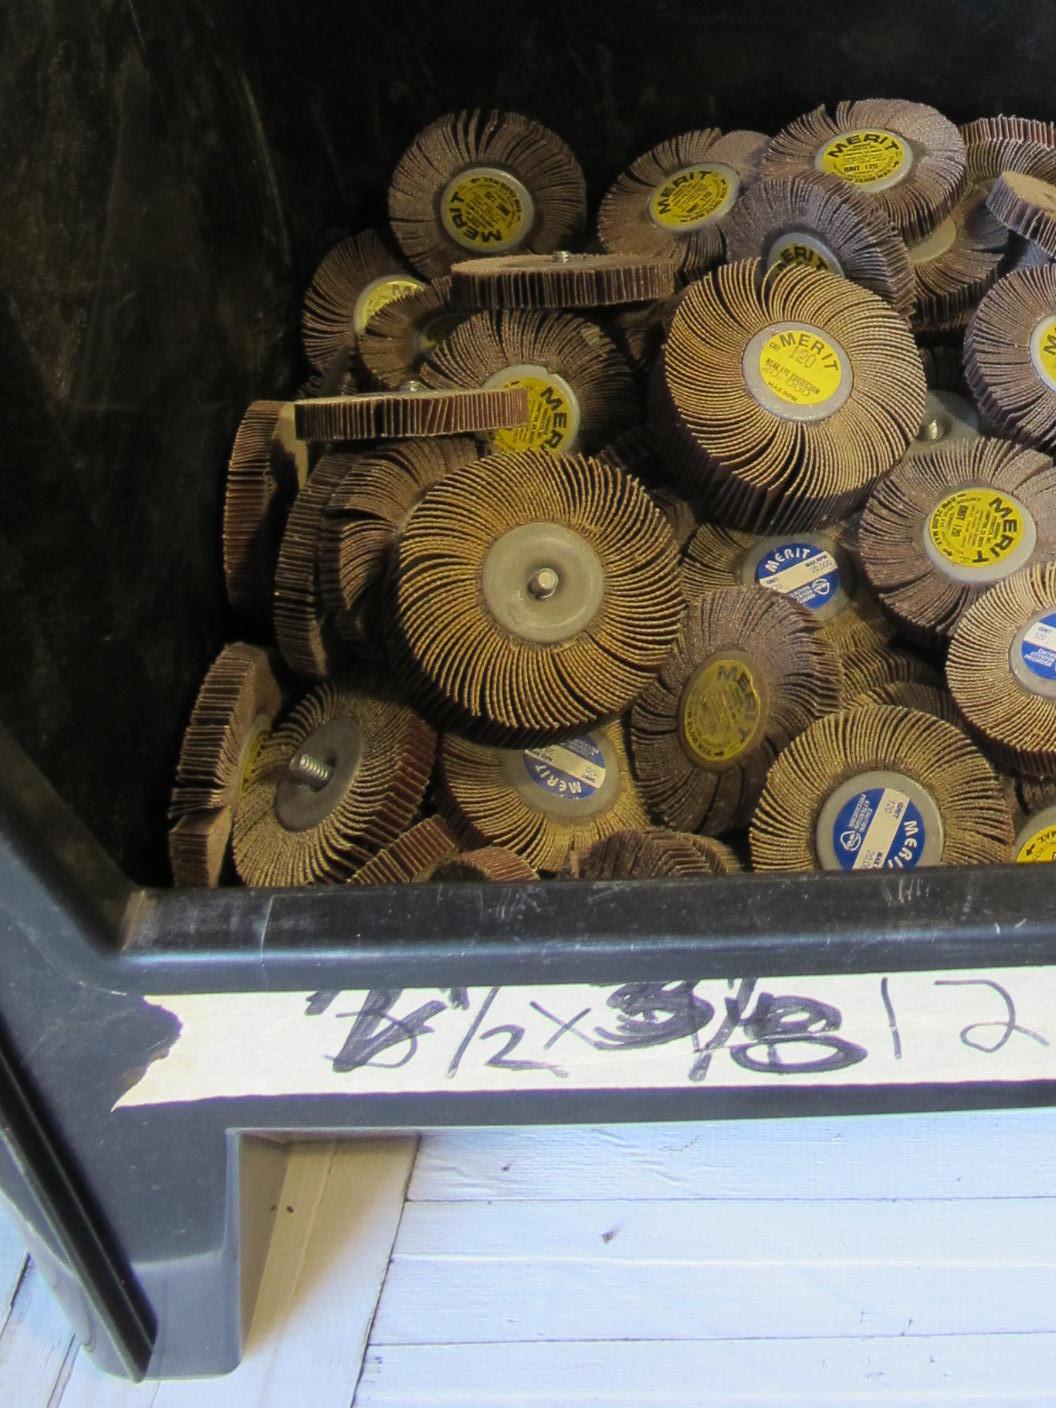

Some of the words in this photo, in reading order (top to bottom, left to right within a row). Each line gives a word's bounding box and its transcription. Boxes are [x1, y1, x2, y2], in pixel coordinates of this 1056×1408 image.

[828, 133, 899, 158] MERIT
[657, 171, 712, 214] MERIT
[449, 191, 503, 243] MERIT
[779, 333, 839, 371] MERIT
[790, 346, 817, 368] 120
[972, 497, 1018, 563] MERIT
[765, 547, 811, 573] MERIT
[535, 764, 582, 794] MERIT
